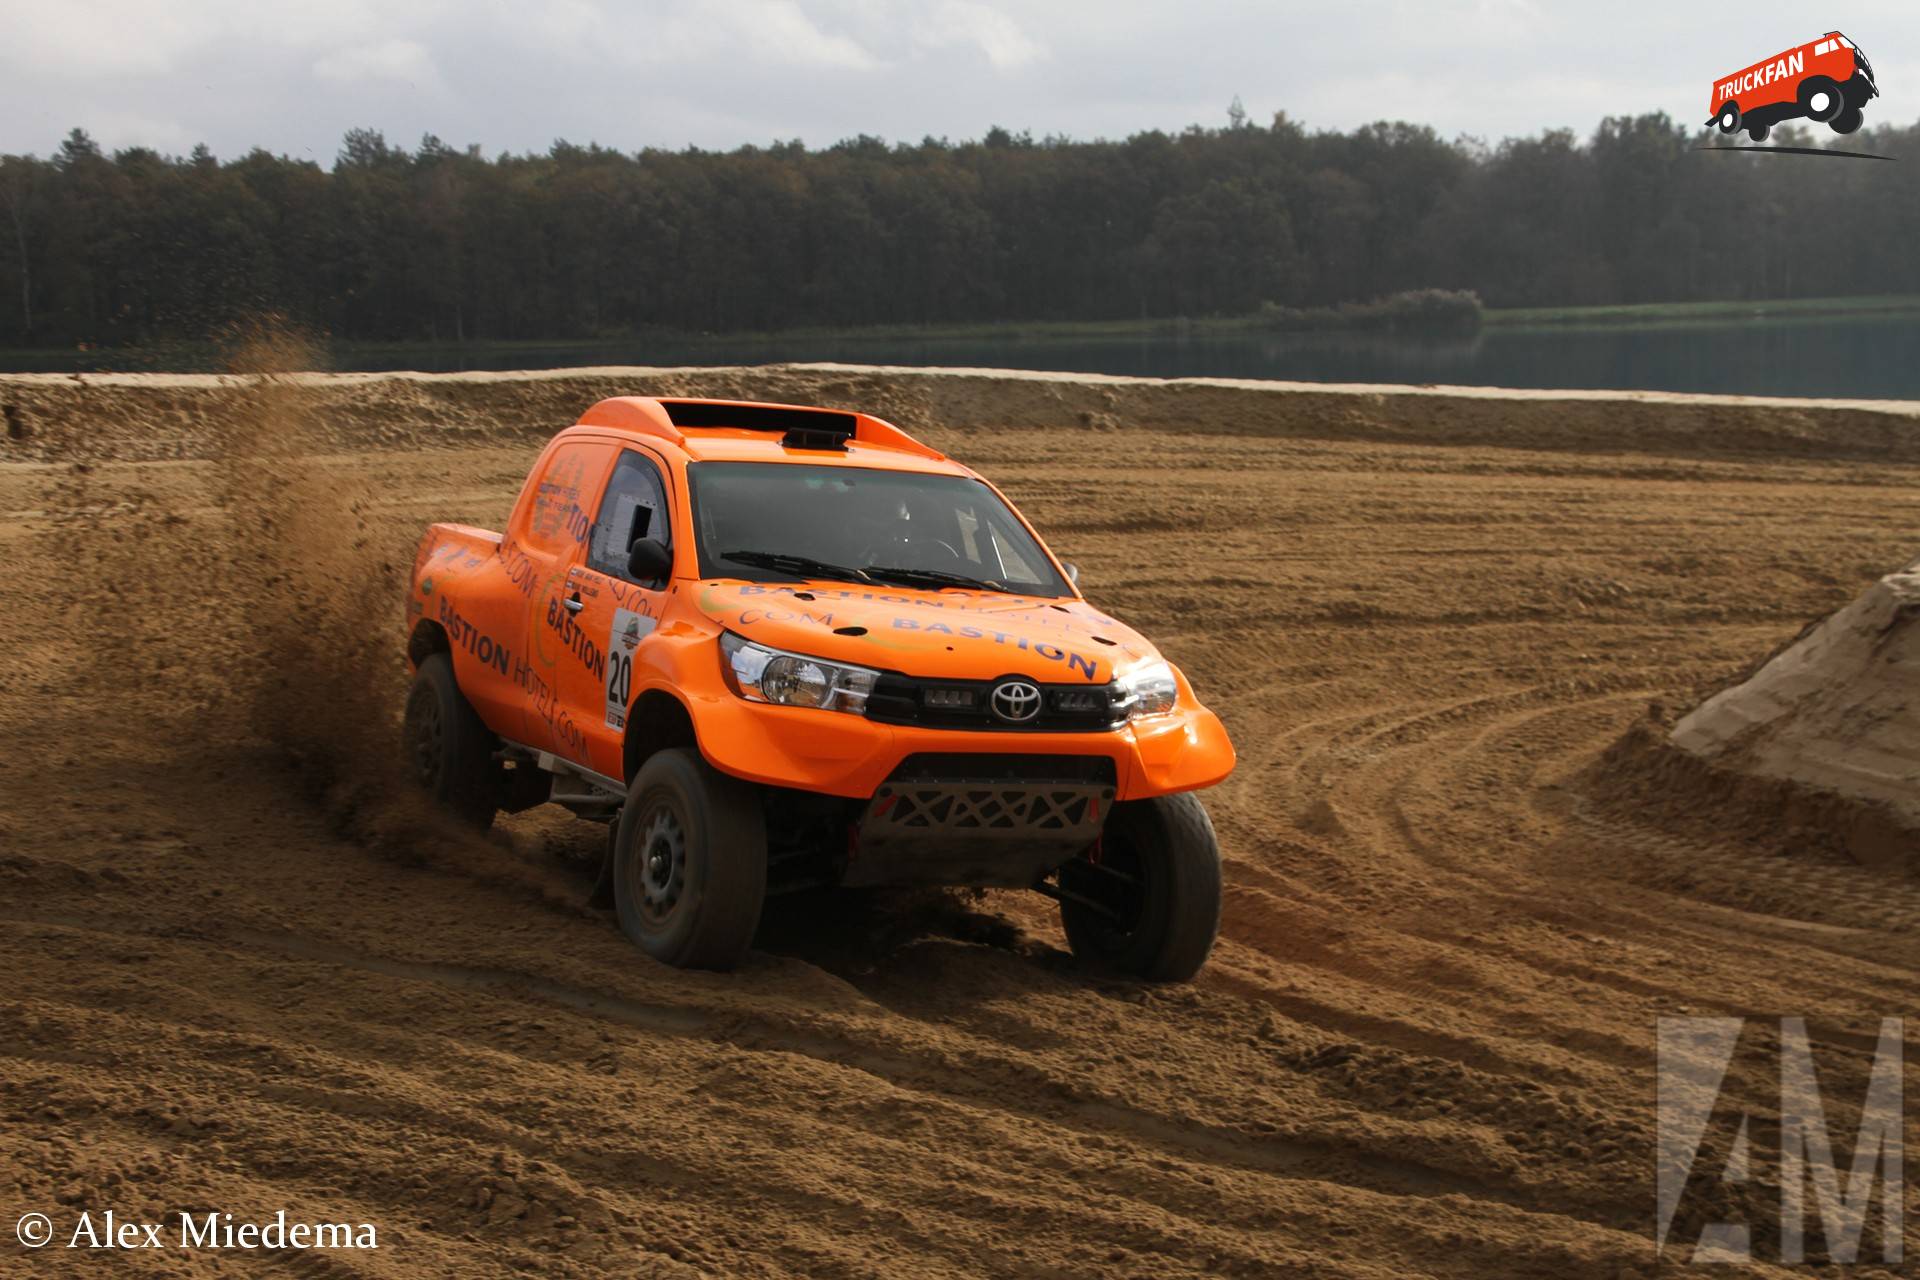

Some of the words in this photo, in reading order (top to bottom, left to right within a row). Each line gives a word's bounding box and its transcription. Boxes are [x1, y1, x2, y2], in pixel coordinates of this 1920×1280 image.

[738, 585, 944, 608] BASTION
[440, 595, 511, 676] BASTION
[547, 596, 605, 683] BASTION
[891, 617, 1097, 682] BASTION
[608, 651, 631, 707] 20
